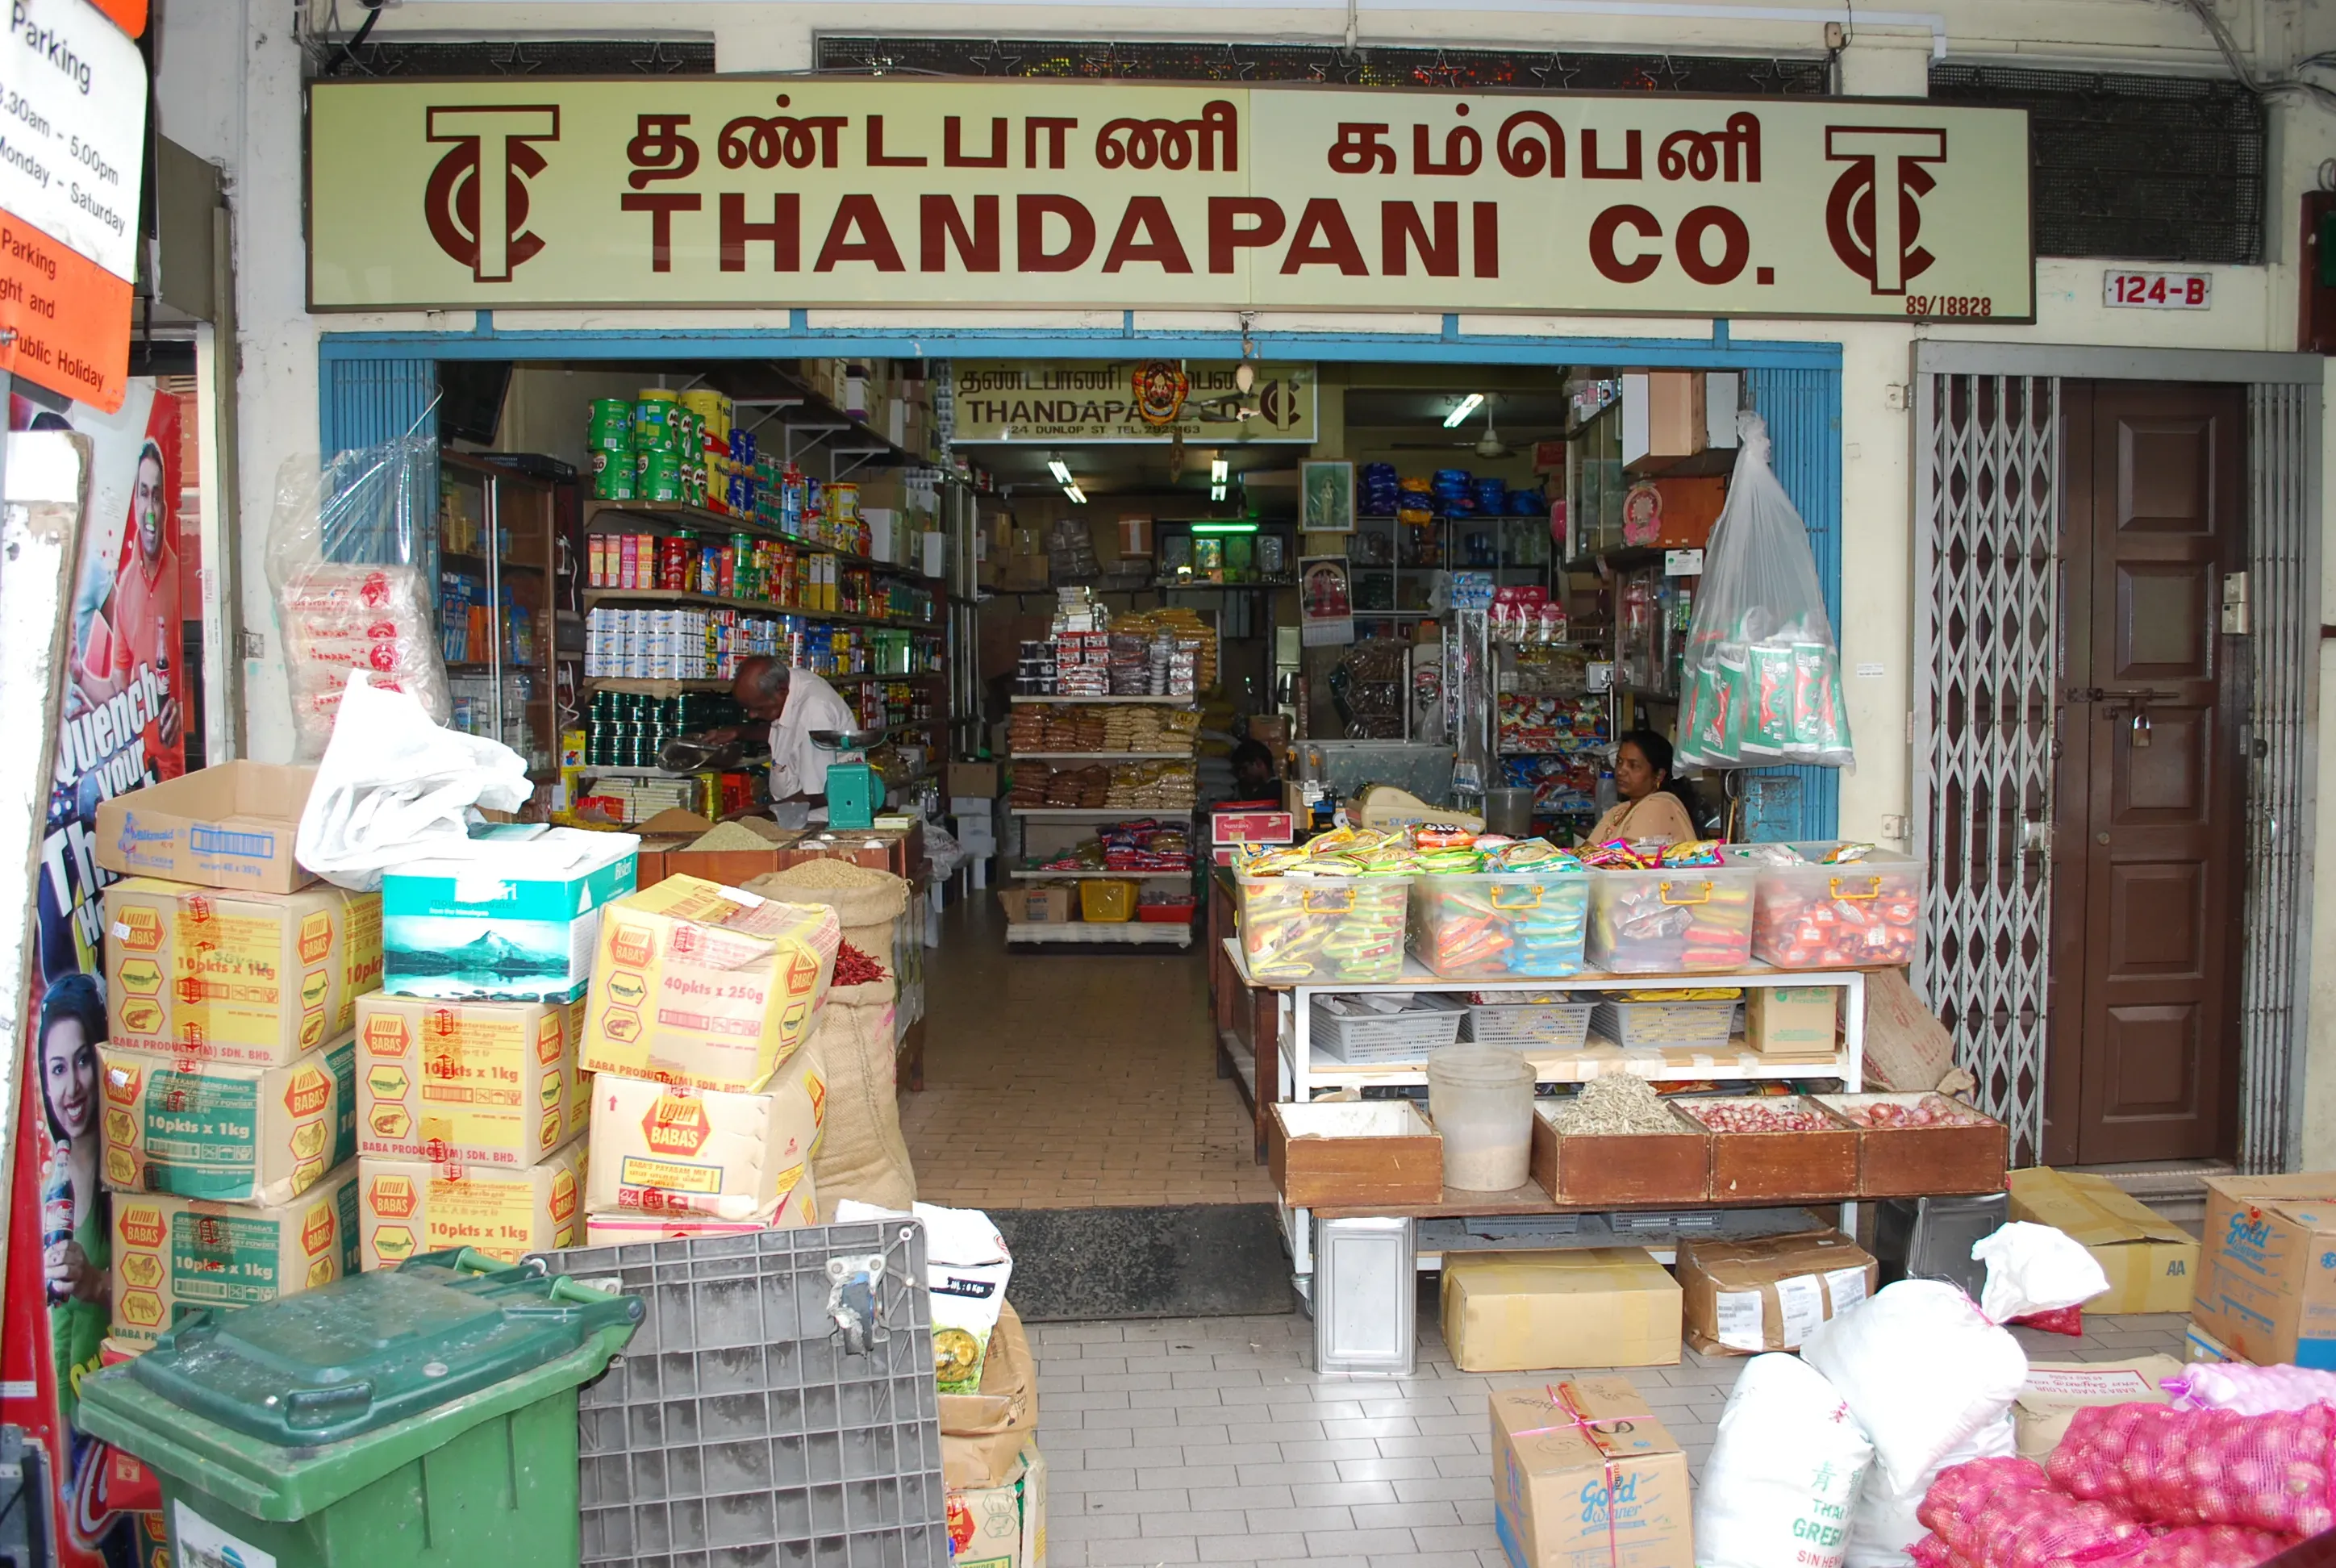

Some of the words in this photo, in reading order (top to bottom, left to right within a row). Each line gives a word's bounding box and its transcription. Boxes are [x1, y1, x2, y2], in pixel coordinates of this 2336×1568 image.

[10, 0, 91, 95] Parking
[70, 136, 119, 186] 5.00pm
[70, 182, 126, 237] Saturday
[621, 193, 1500, 278] THANDAPANI
[1588, 203, 1775, 285] CO.
[2, 228, 56, 281] Parking
[0, 277, 23, 303] ght
[30, 294, 55, 319] and
[2113, 276, 2206, 306] 124-B
[1906, 296, 1992, 317] 89/18828
[8, 325, 52, 365] Public
[58, 349, 105, 392] Holiday
[966, 400, 1192, 423] THANDAPA
[1036, 426, 1084, 434] DUNLOP
[53, 662, 159, 787] Quench
[347, 954, 383, 985] 10pkt
[664, 976, 711, 995] 40pkts
[729, 985, 764, 1005] 250g
[491, 1065, 519, 1083] 1kg
[588, 1058, 615, 1073] BABA
[695, 1079, 720, 1091] SDN.
[148, 1115, 199, 1133] 10pkts
[219, 1122, 250, 1139] 1kg
[362, 1141, 389, 1153] BABA
[466, 1150, 489, 1161] SDN.
[493, 1152, 518, 1163] BHD.
[431, 1222, 480, 1239] 10pkts
[500, 1225, 528, 1242] 1kg
[244, 1263, 273, 1279] 1kg
[2166, 1261, 2186, 1276] AA
[115, 1328, 140, 1340] BABA
[1592, 1504, 1642, 1524] Wnner
[1812, 1498, 1844, 1520] THAI
[1796, 1549, 1821, 1567] SIN
